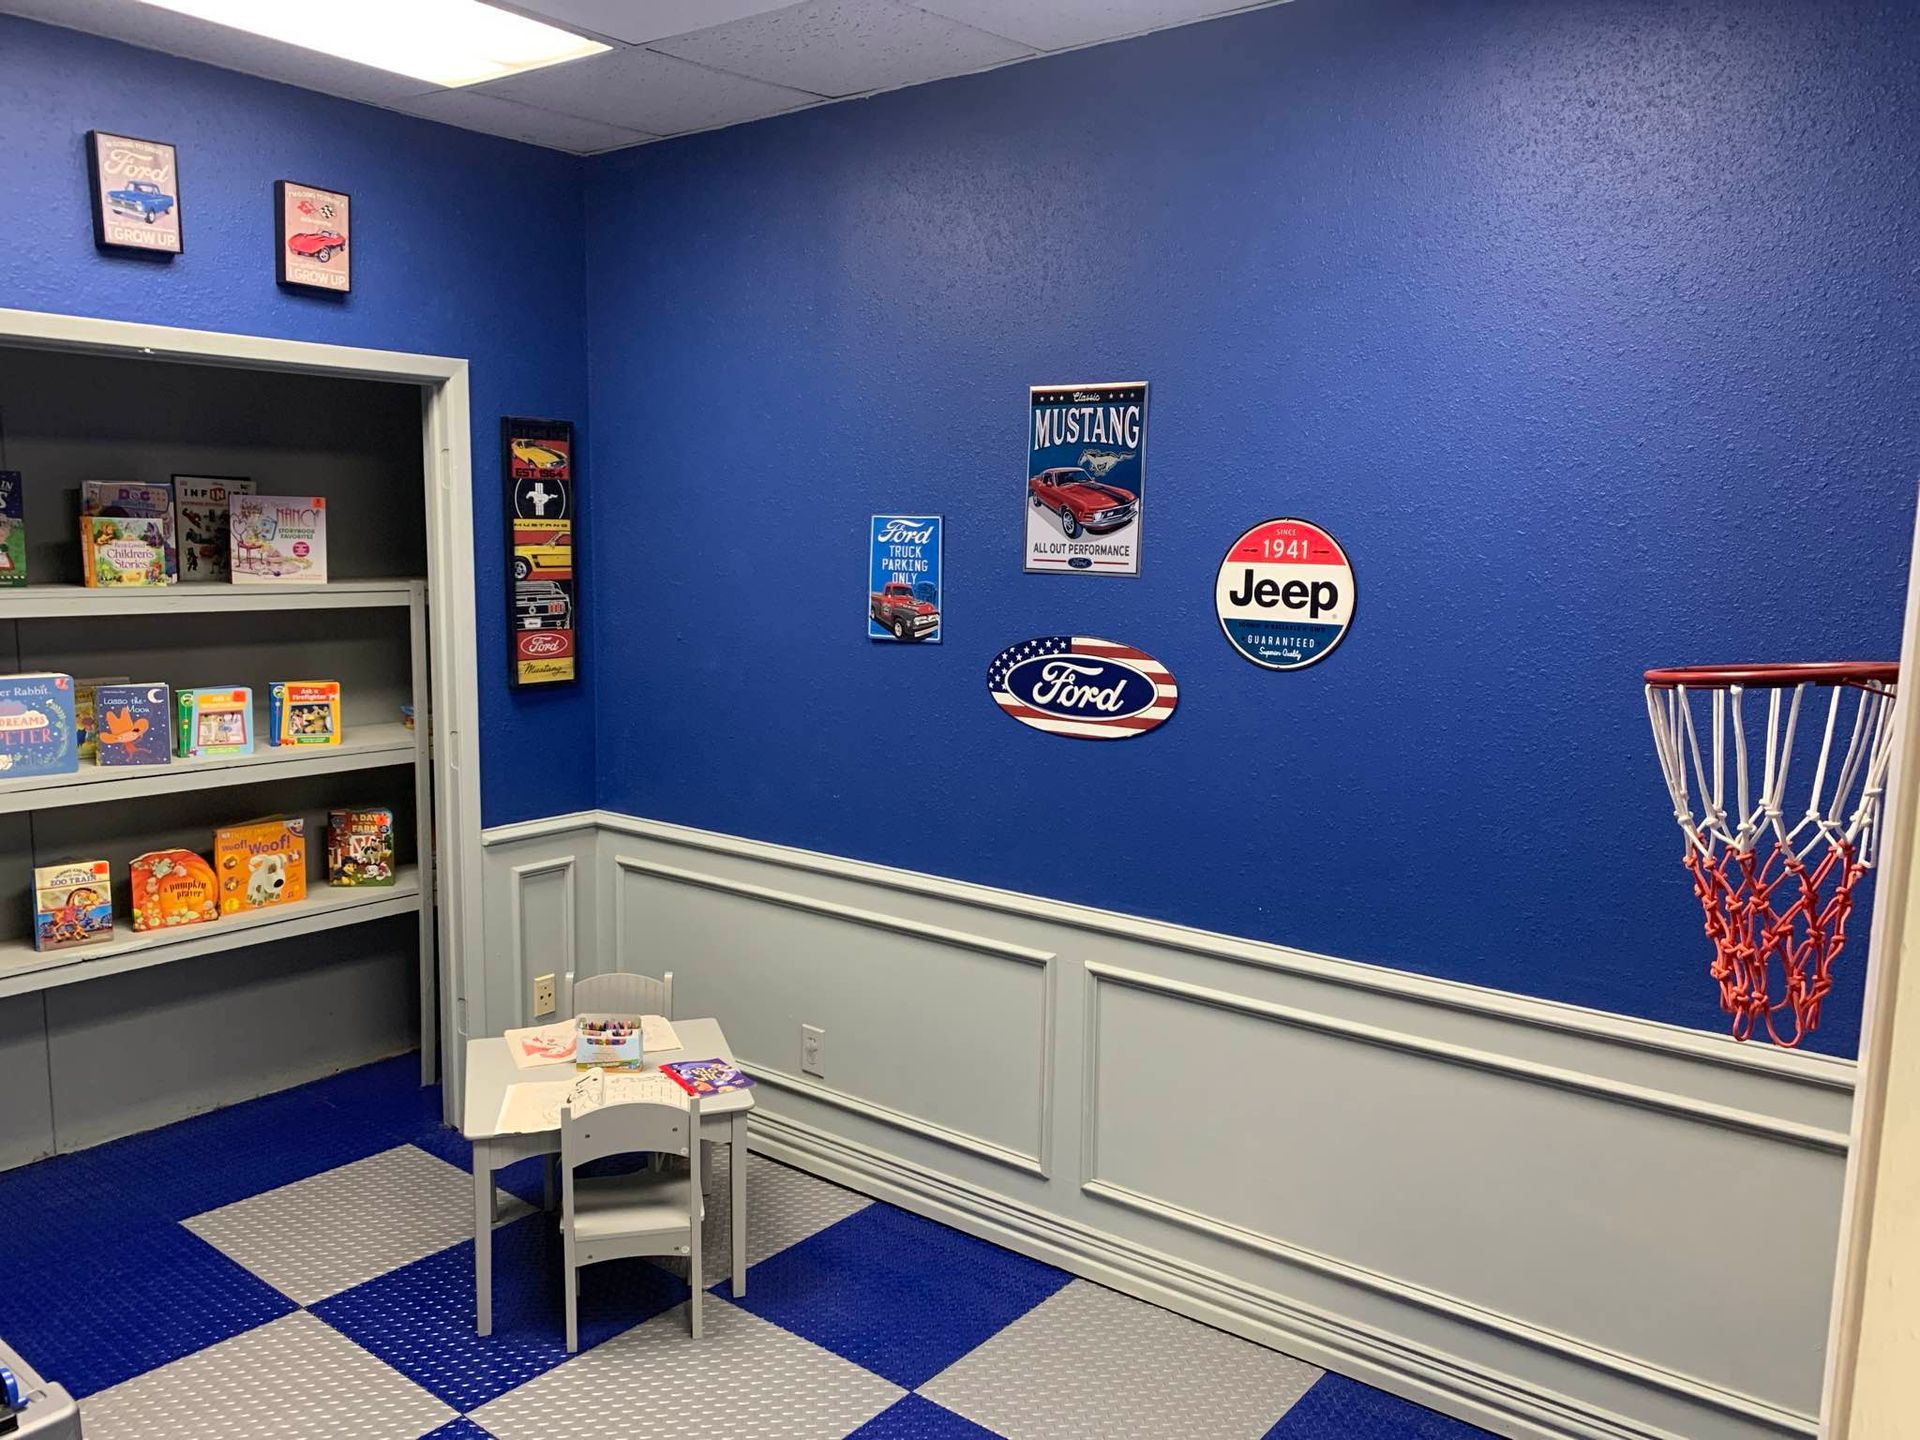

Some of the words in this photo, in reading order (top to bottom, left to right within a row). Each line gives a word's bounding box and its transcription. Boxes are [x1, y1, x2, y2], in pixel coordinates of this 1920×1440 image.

[104, 150, 169, 182] Ford
[114, 228, 157, 243] GROW
[158, 231, 176, 246] UP
[294, 269, 329, 284] GROW
[331, 272, 346, 286] UP
[1073, 391, 1101, 402] Classic
[1034, 405, 1140, 450] MUSTANG
[515, 468, 536, 477] EST
[878, 519, 935, 544] Ford
[1276, 528, 1297, 536] SINCE
[889, 545, 922, 558] TRUCK
[1033, 543, 1048, 554] ALL
[1050, 543, 1067, 555] OUT
[1068, 544, 1130, 557] PERFORMANCE
[1263, 539, 1309, 560] 1941
[114, 559, 149, 569] Stories
[882, 558, 929, 572] PARKING
[892, 572, 918, 585] ONLY
[1229, 568, 1339, 619] Jeep
[529, 634, 561, 651] Ford
[1247, 634, 1315, 648] GUARANTEED
[523, 660, 568, 675] Mustang
[14, 685, 49, 697] Rabbit
[1032, 661, 1128, 712] Ford
[103, 697, 128, 705] Lasso
[127, 705, 151, 713] Moon
[352, 825, 379, 833] FARM
[69, 874, 97, 884] TRAIN
[169, 880, 207, 893] pumpkin
